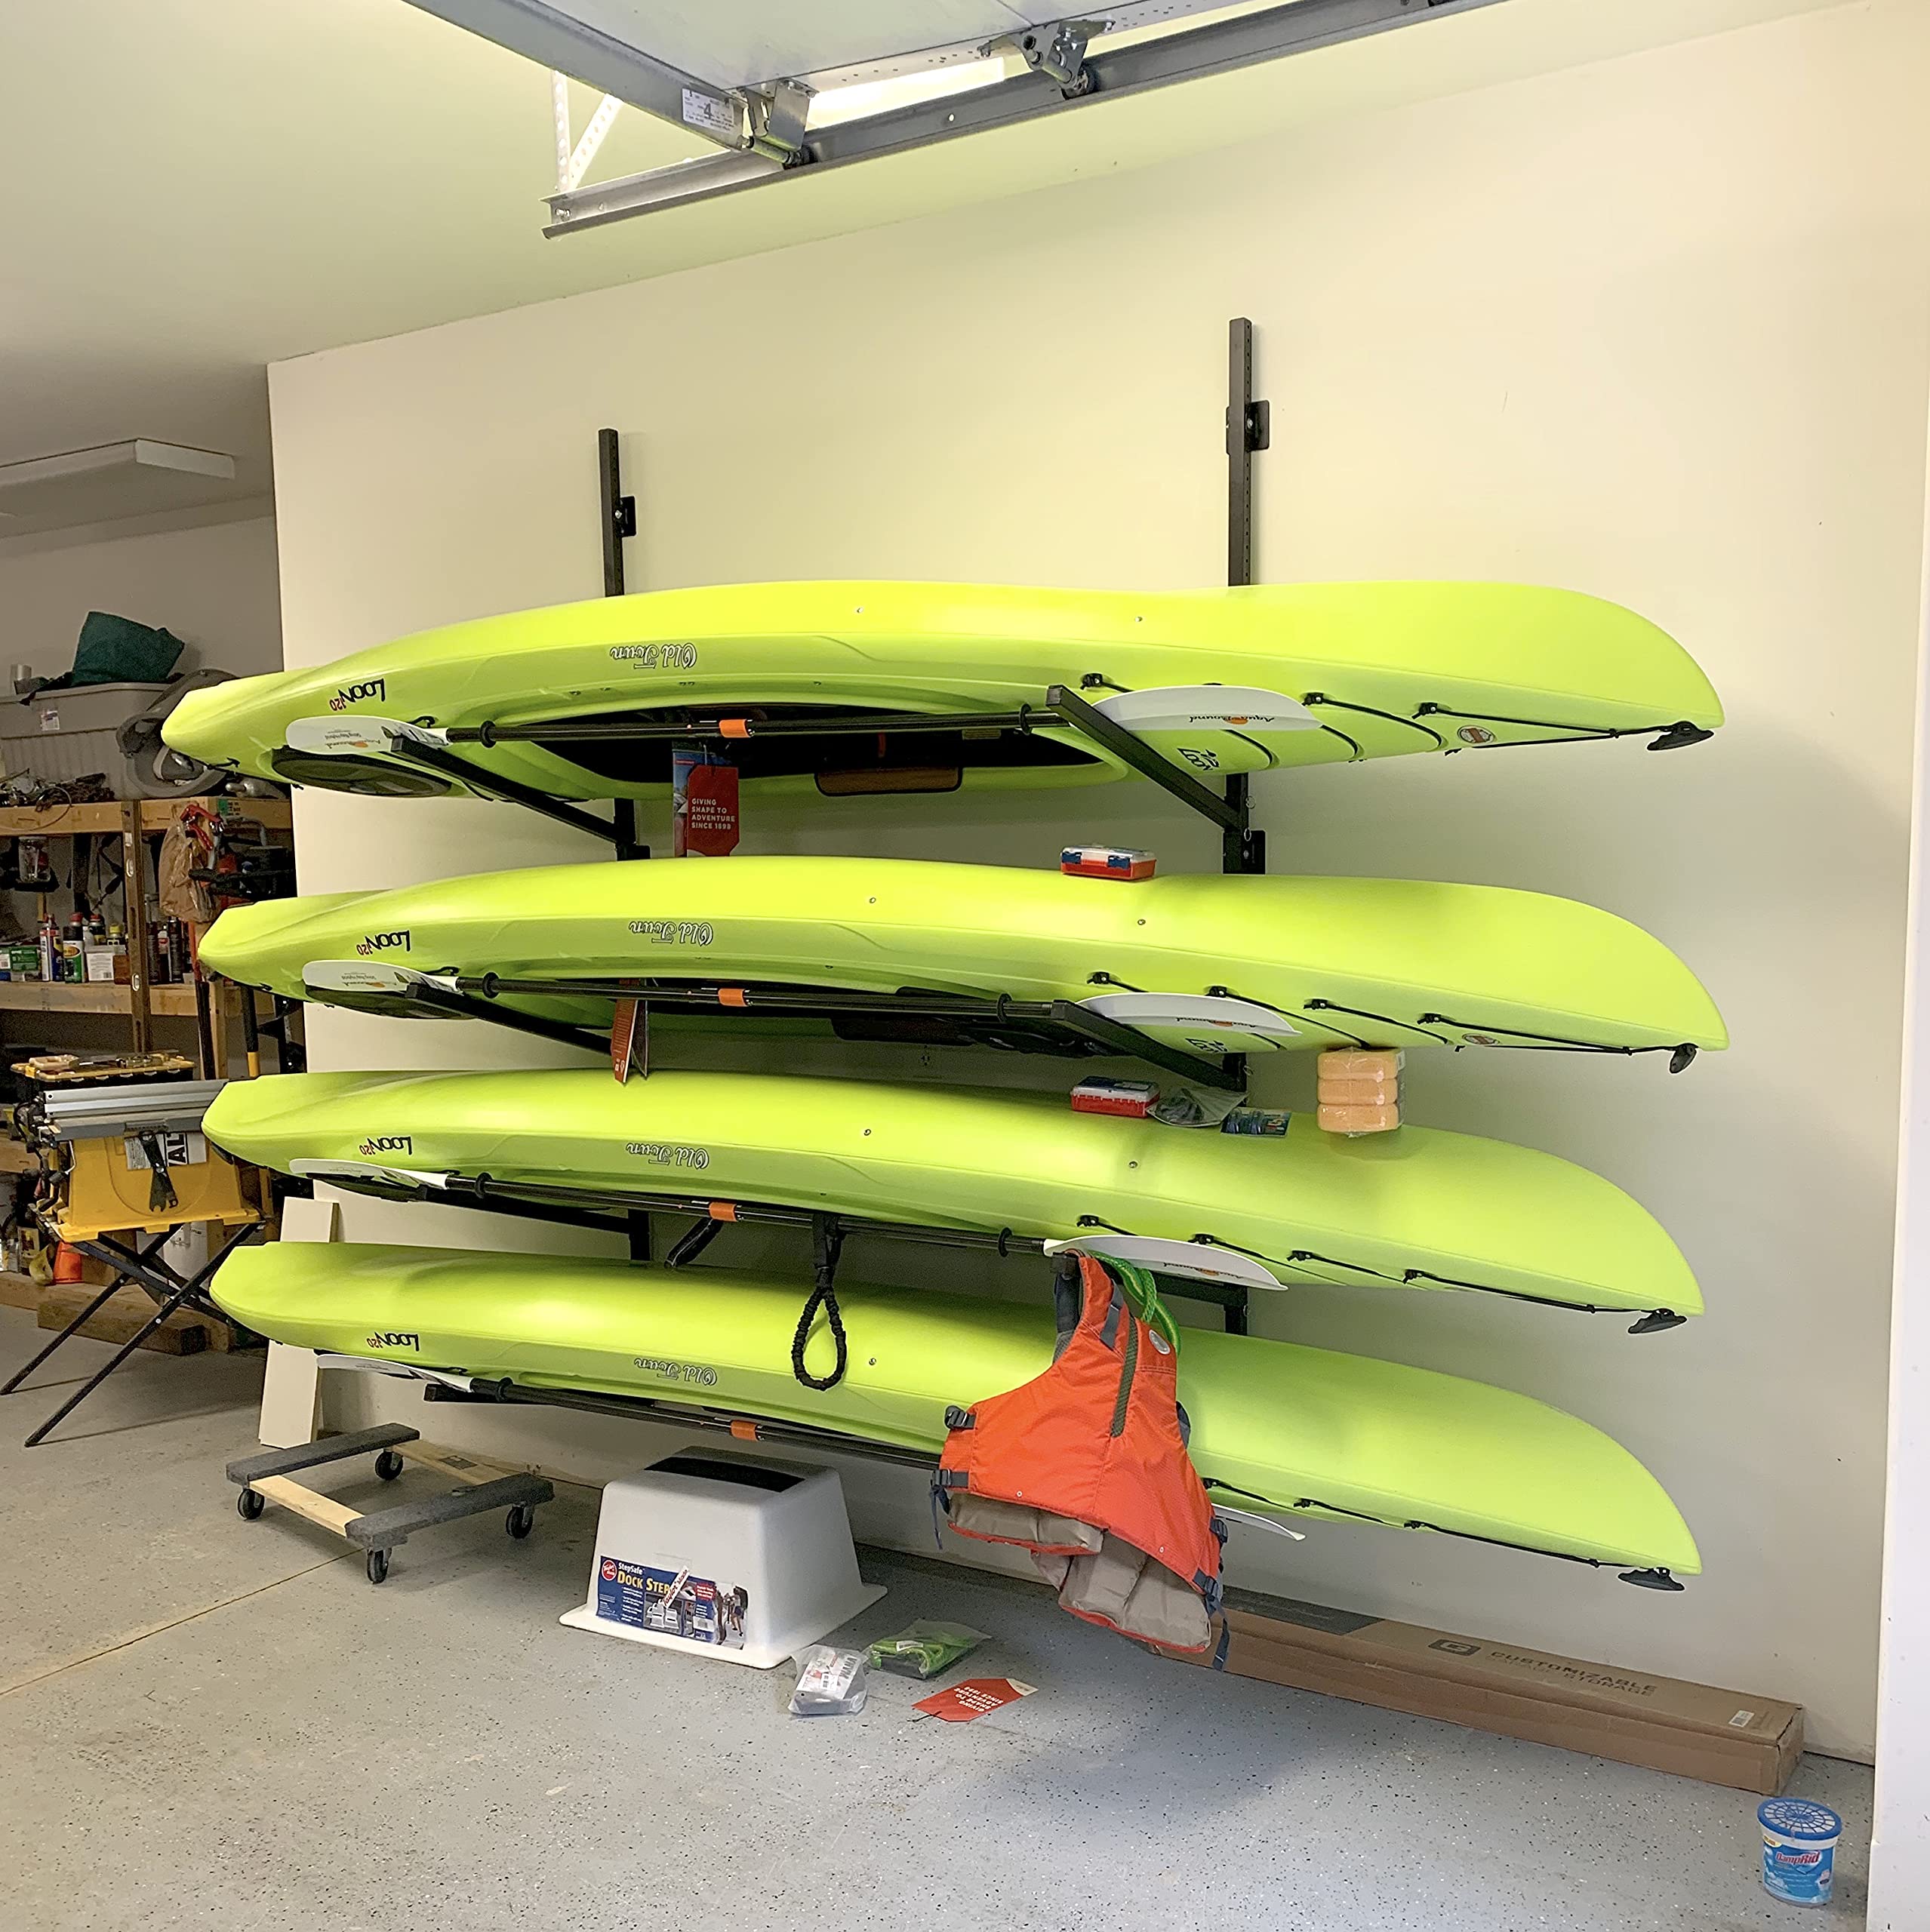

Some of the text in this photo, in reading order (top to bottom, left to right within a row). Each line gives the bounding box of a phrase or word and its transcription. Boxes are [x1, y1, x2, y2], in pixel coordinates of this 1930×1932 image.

[609, 642, 697, 669] Old Town
[329, 697, 346, 712] 120
[691, 798, 716, 806] GIVING
[691, 805, 716, 814] SHAPE
[691, 814, 736, 823] ADVENTURE
[691, 821, 713, 829] SINCE
[628, 921, 714, 947] Old Town
[356, 943, 374, 956] 120
[166, 1132, 187, 1167] AL
[359, 1144, 377, 1155] 120
[625, 1142, 710, 1170] Old Town
[366, 1337, 384, 1349] 120
[634, 1357, 718, 1386] Old Town
[617, 1561, 644, 1576] StepSafe
[617, 1571, 671, 1595] DOCK STEP
[662, 1585, 678, 1606] Taylor
[1490, 1651, 1658, 1691] CUSTOMIZABLE
[1563, 1672, 1657, 1697] STORAGE
[953, 1687, 999, 1707] ADVENTURE
[965, 1697, 992, 1710] SHAPE
[980, 1693, 1004, 1705] SINCE
[958, 1700, 985, 1712] GIVING
[1776, 1850, 1821, 1866] DampRid
